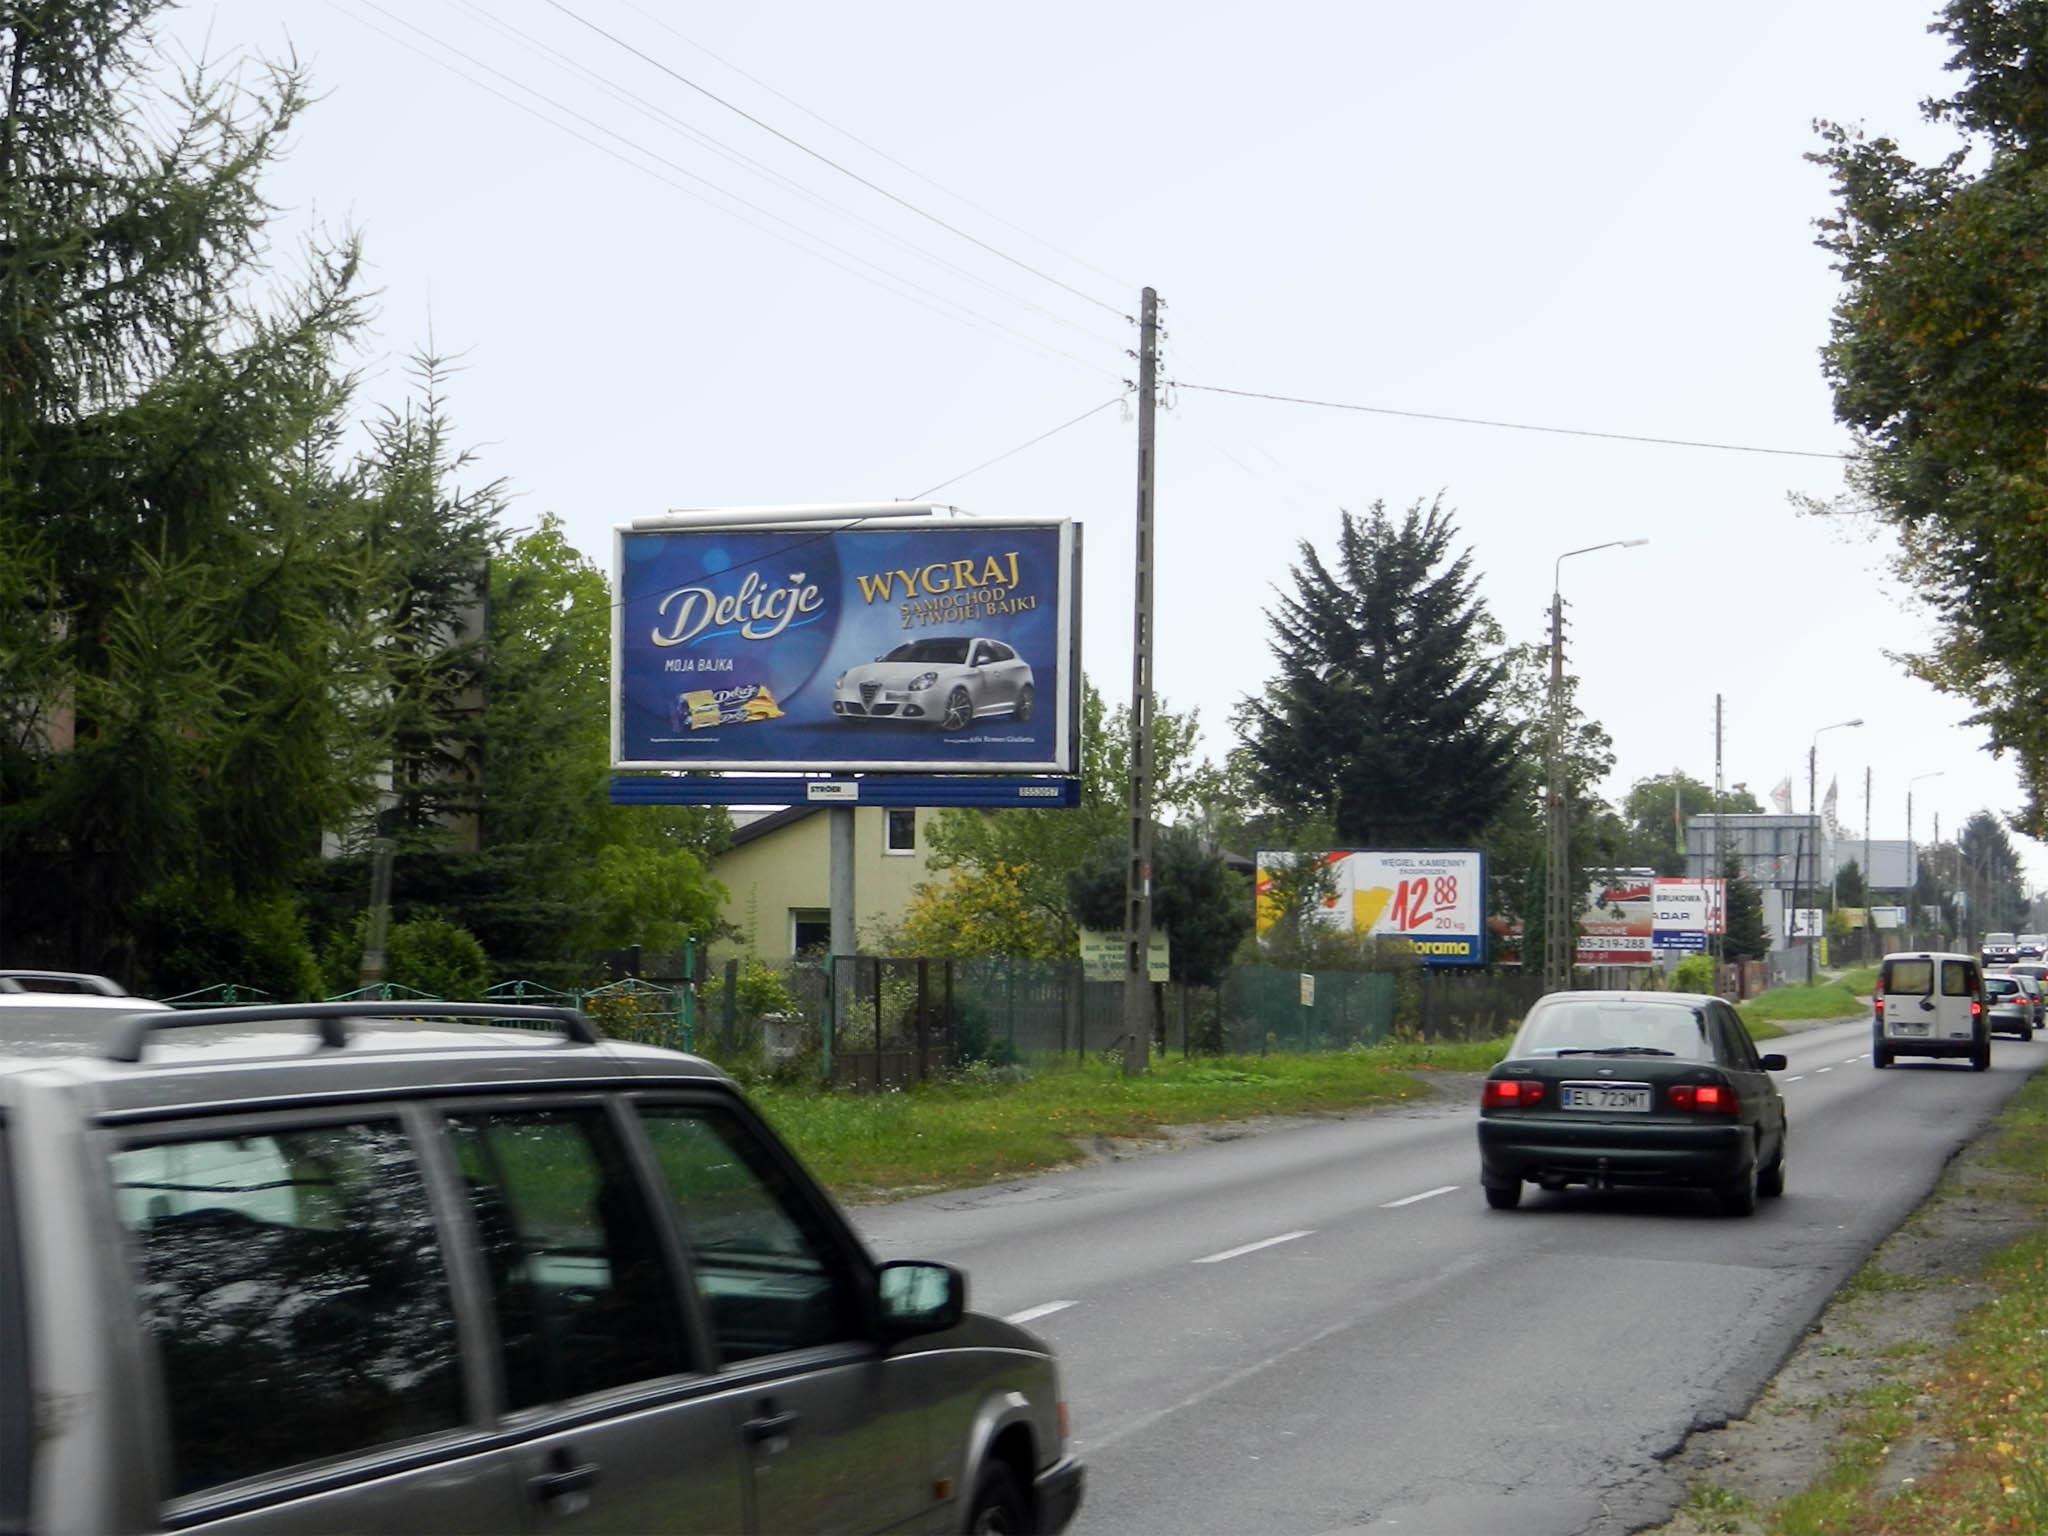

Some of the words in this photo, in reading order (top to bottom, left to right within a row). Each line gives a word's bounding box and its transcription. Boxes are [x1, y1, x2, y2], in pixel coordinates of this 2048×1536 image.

[856, 552, 1020, 605] WYGRAJ
[651, 572, 824, 648] Delicje
[899, 586, 1006, 616] SAMOCHÓD
[902, 614, 913, 630] Z
[918, 604, 982, 627] TWOJEJ
[986, 595, 1037, 617] BAJKI
[665, 659, 695, 673] MOJA
[698, 658, 733, 671] BAJKA
[1380, 858, 1416, 868] WĘGIEL
[1418, 858, 1466, 867] KAMIENNY
[1391, 877, 1433, 931] 12
[1434, 875, 1457, 905] 88
[1656, 894, 1701, 902] BRUKOWA
[1436, 918, 1451, 929] 20
[1574, 1091, 1593, 1105] EL
